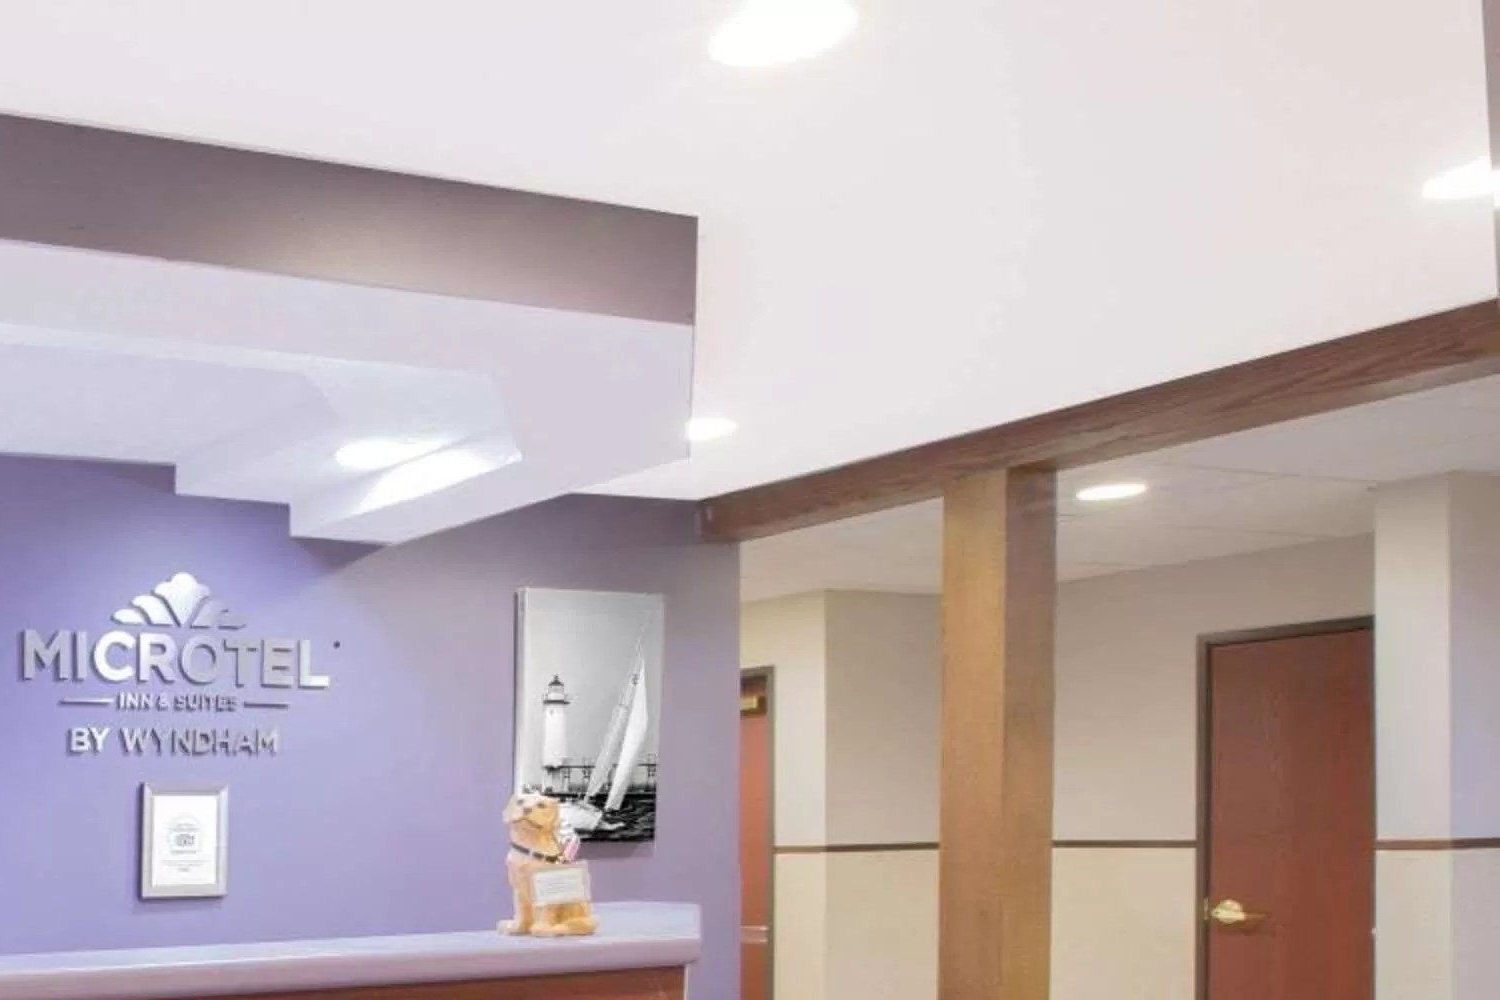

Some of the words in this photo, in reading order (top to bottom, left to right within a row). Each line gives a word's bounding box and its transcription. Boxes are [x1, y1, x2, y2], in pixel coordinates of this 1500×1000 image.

[19, 629, 331, 690] MICROTEL
[116, 691, 152, 712] INN
[173, 692, 238, 713] SUITES
[67, 727, 111, 757] BY
[120, 727, 279, 758] WYNDHAM
